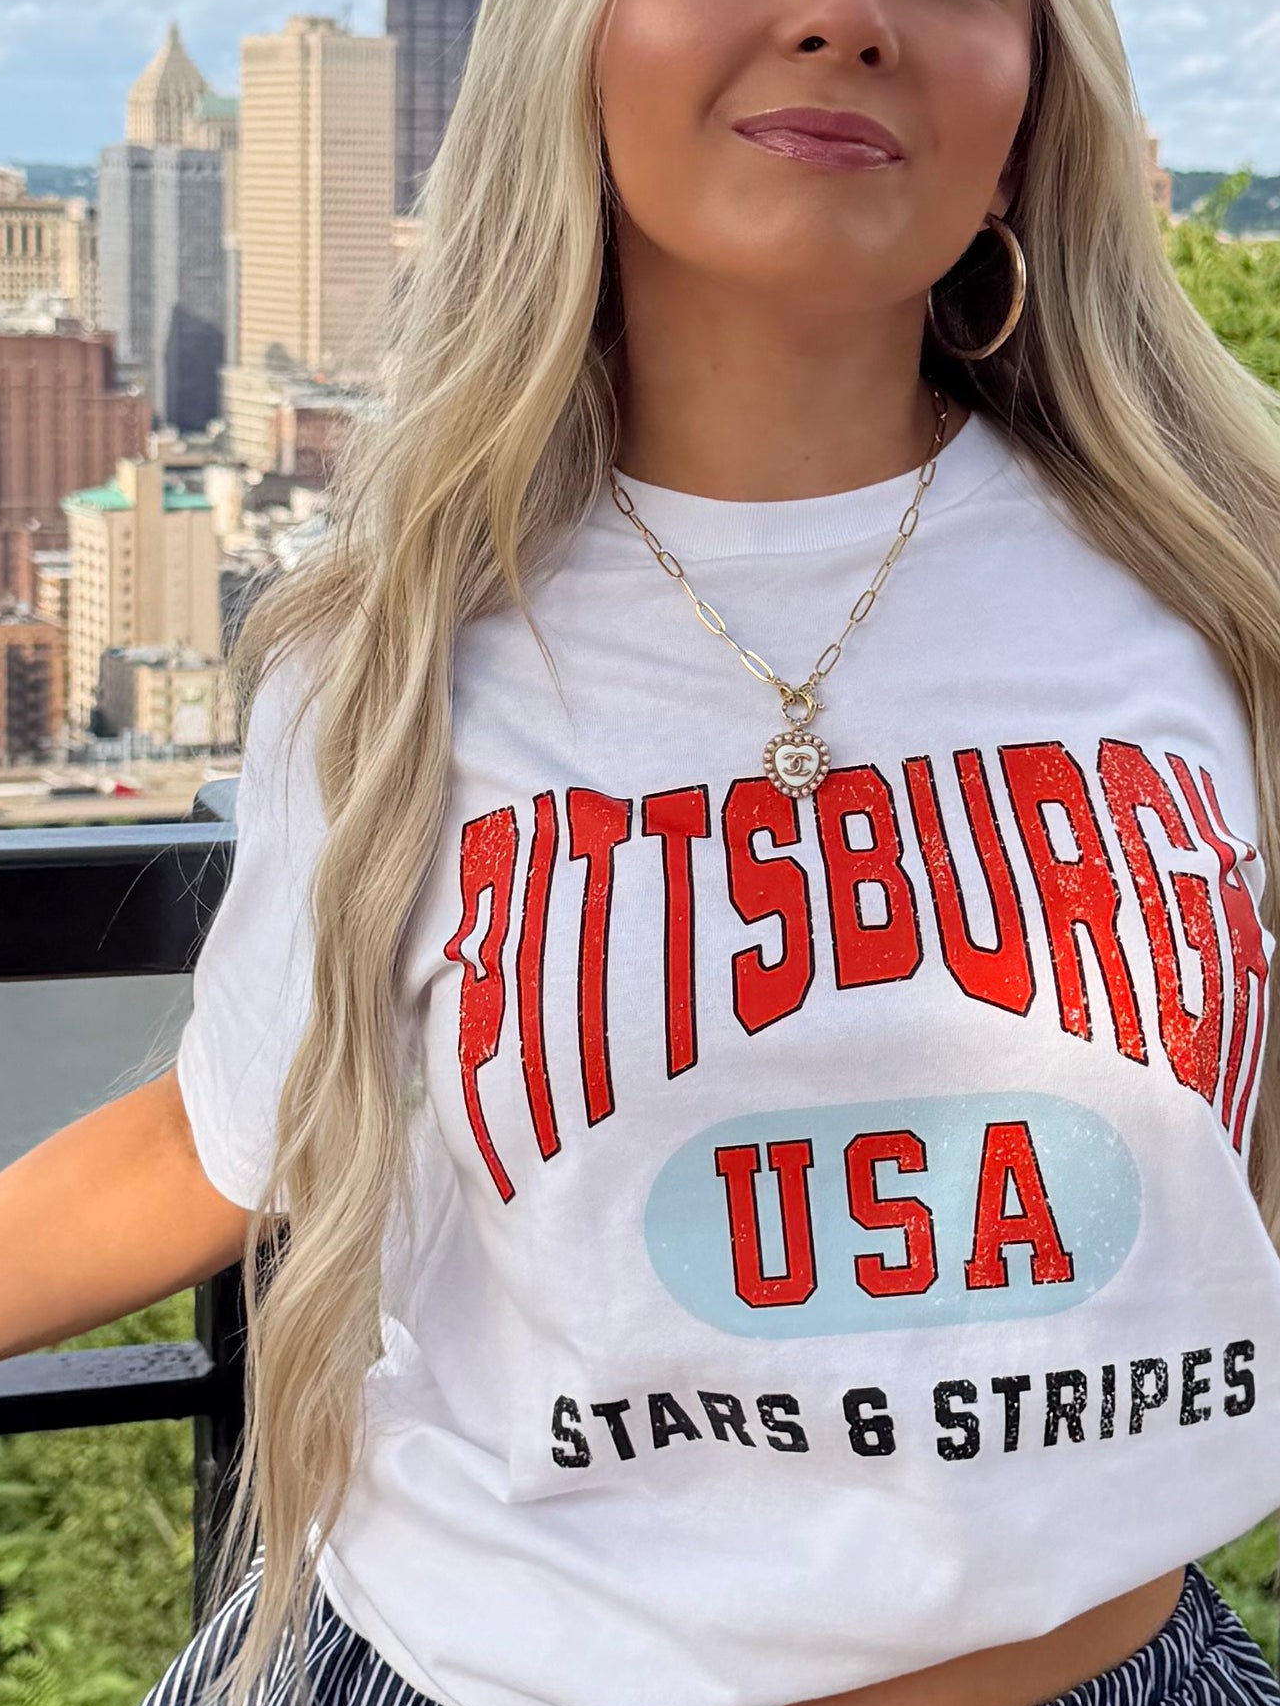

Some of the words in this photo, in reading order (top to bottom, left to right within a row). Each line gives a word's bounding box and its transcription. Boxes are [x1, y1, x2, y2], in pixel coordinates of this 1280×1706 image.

[713, 1120, 1075, 1309] USA
[549, 1392, 810, 1469] STARS
[841, 1385, 897, 1458] &
[931, 1338, 1257, 1462] STRIPES
